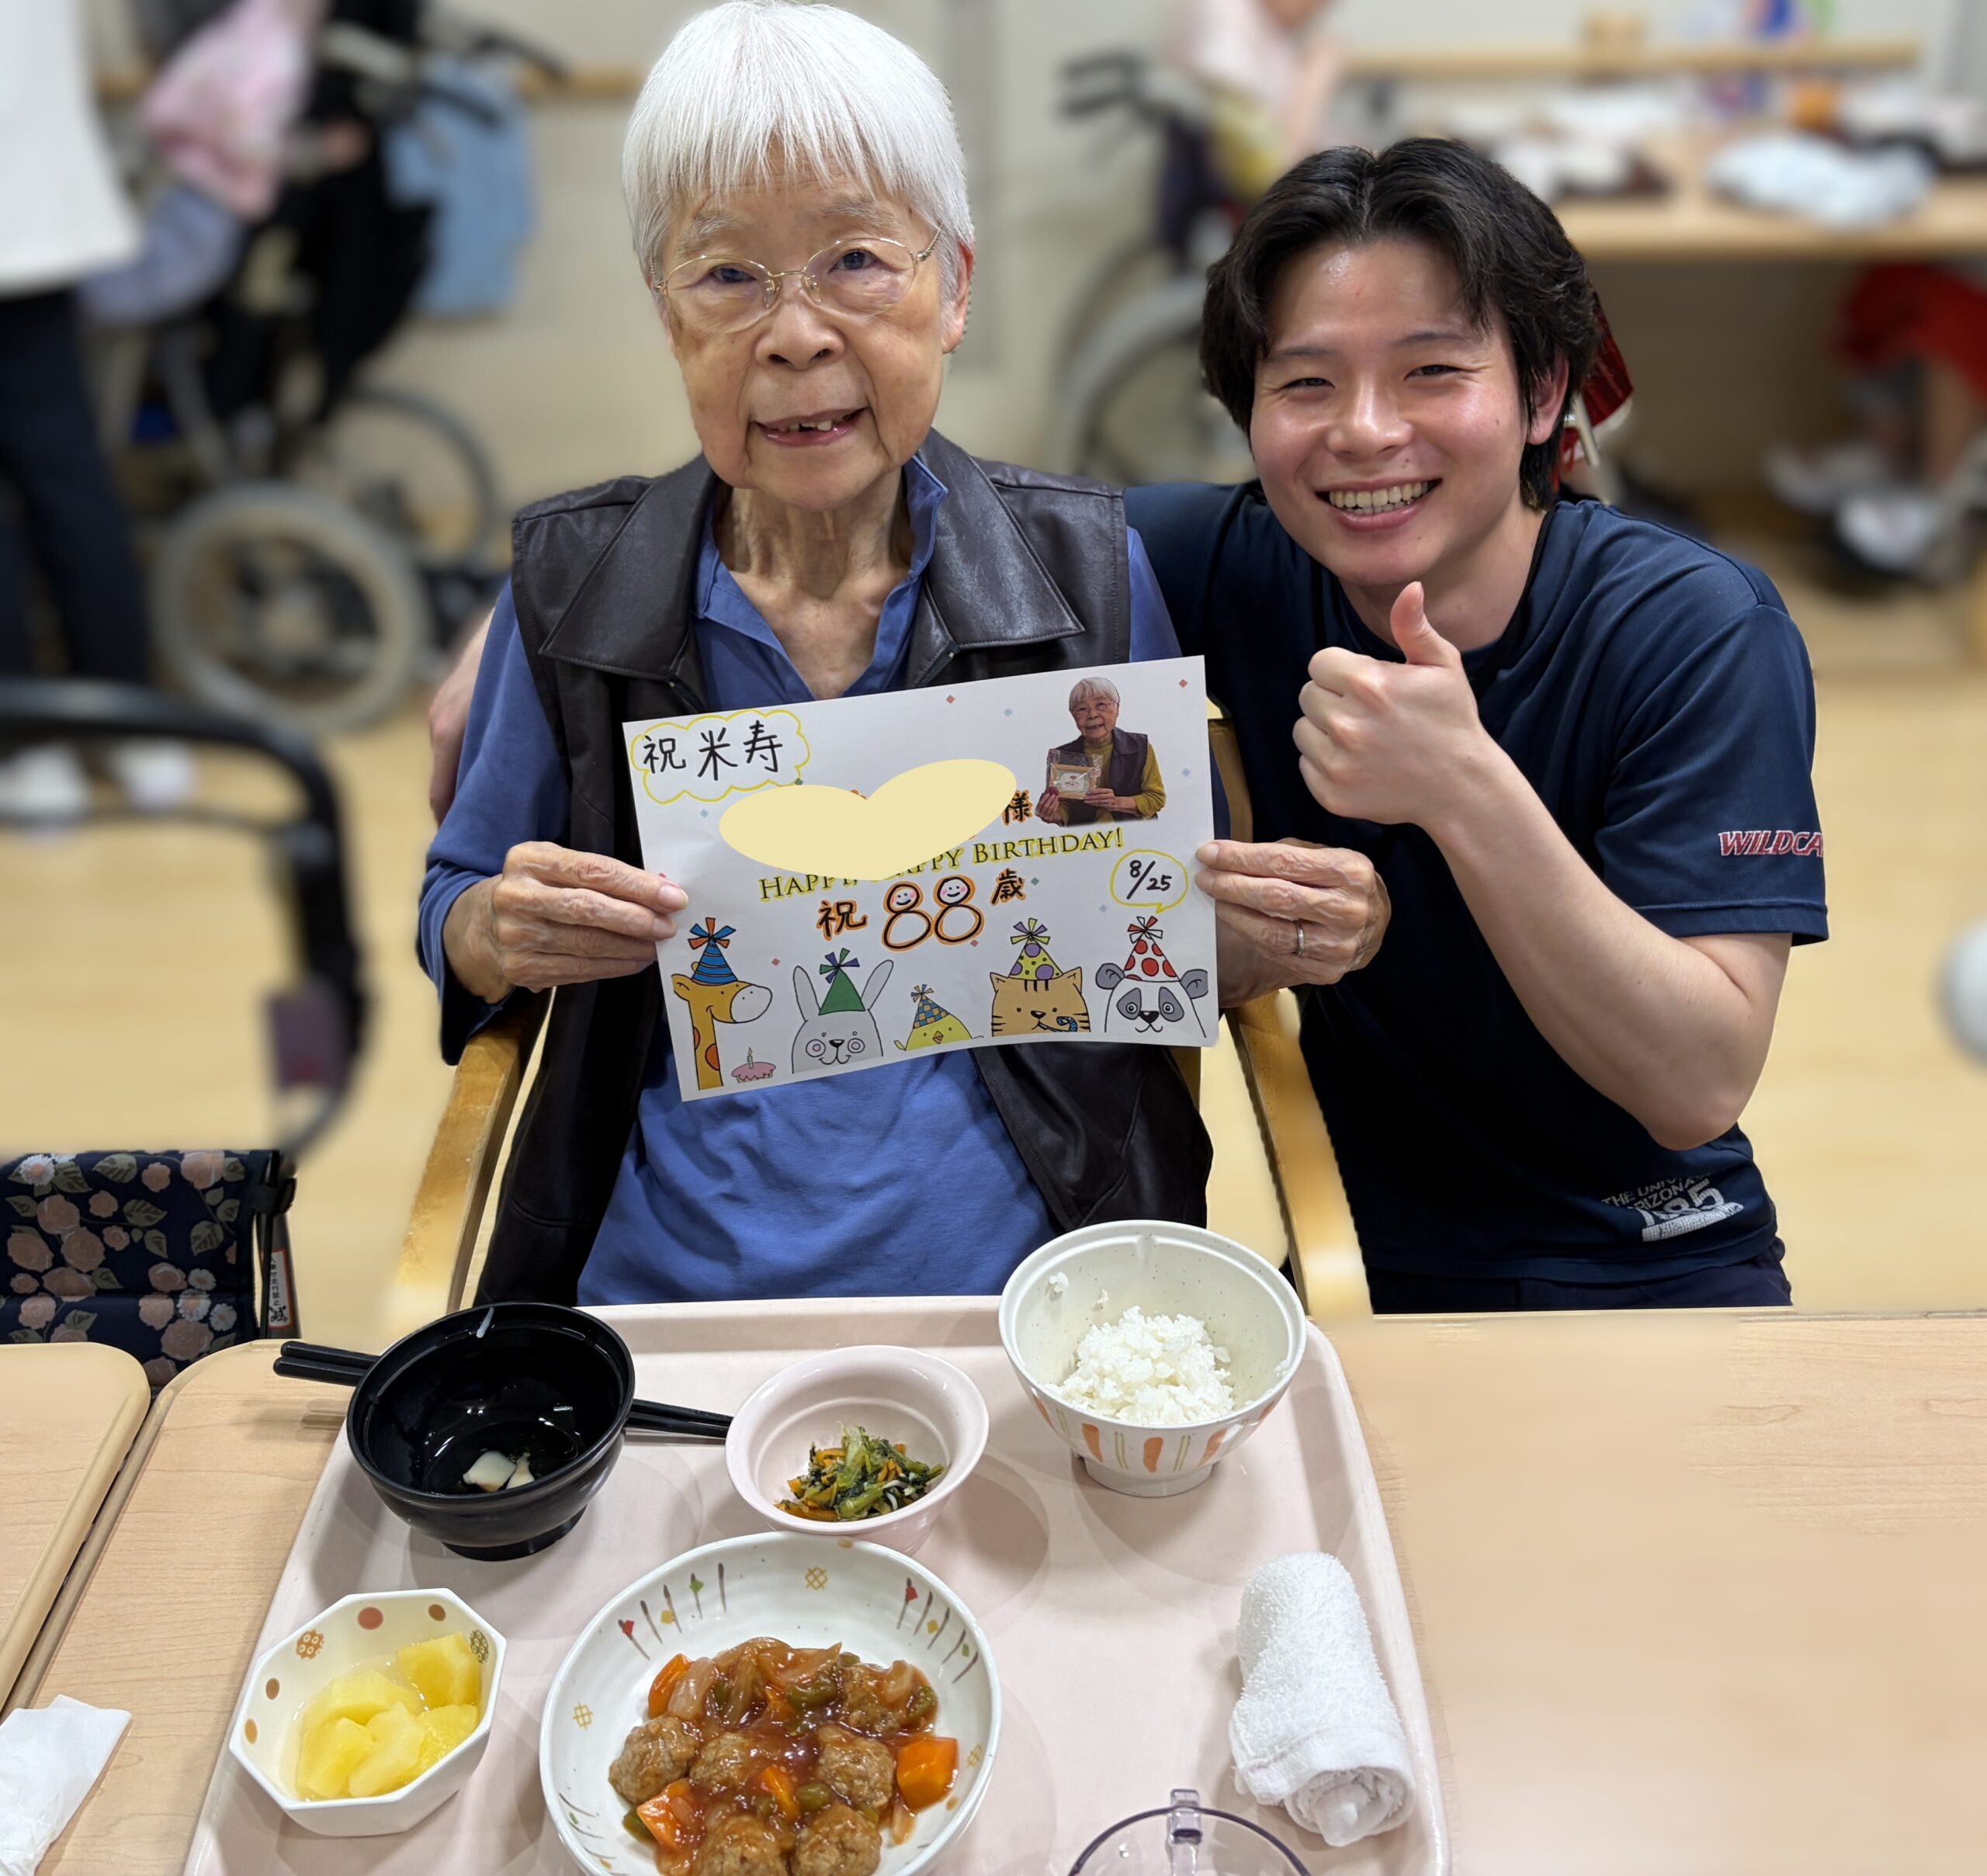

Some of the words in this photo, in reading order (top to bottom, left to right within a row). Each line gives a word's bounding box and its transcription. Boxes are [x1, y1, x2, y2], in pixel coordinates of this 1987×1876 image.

[643, 720, 783, 781] 祝米寿
[973, 827, 1122, 864] BIRTHDAY!
[1126, 859, 1173, 900] 8/25
